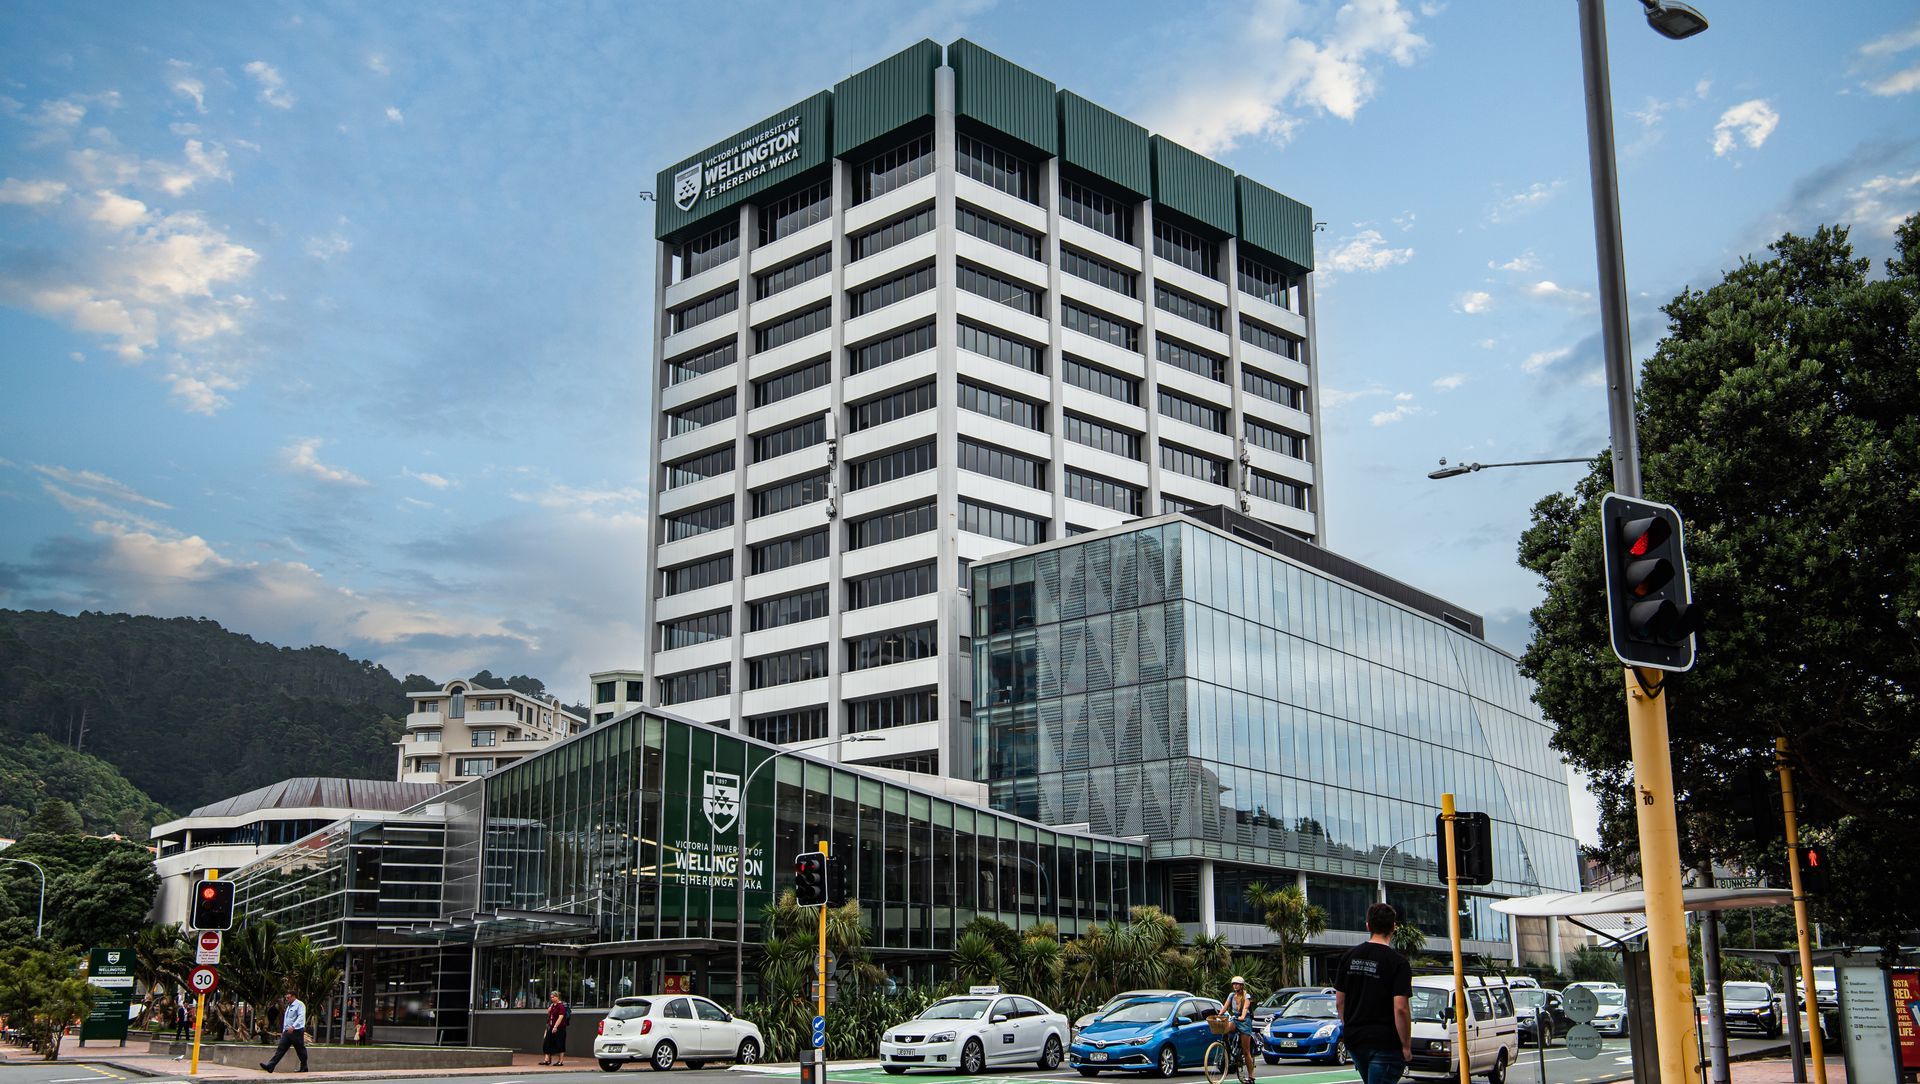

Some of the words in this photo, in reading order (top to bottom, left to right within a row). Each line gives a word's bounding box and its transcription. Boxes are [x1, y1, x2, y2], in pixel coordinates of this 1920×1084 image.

[705, 146, 739, 167] VICTORIA
[741, 122, 787, 151] UNIVERSITY
[788, 116, 800, 127] OF
[705, 127, 800, 186] WELLINGTON
[705, 187, 716, 199] TE
[720, 164, 766, 193] HERENGA
[769, 148, 799, 169] WAKA
[1642, 795, 1654, 806] 10
[675, 840, 709, 851] VICTORIA
[712, 844, 752, 856] UNIVERTY
[753, 848, 763, 857] OF
[675, 852, 763, 876] WELLINGON
[675, 874, 685, 884] TE
[689, 875, 734, 887] HERENGA
[1720, 879, 1746, 889] BUNNY
[195, 974, 212, 985] 30
[1898, 1027, 1916, 1037] LIFE.
